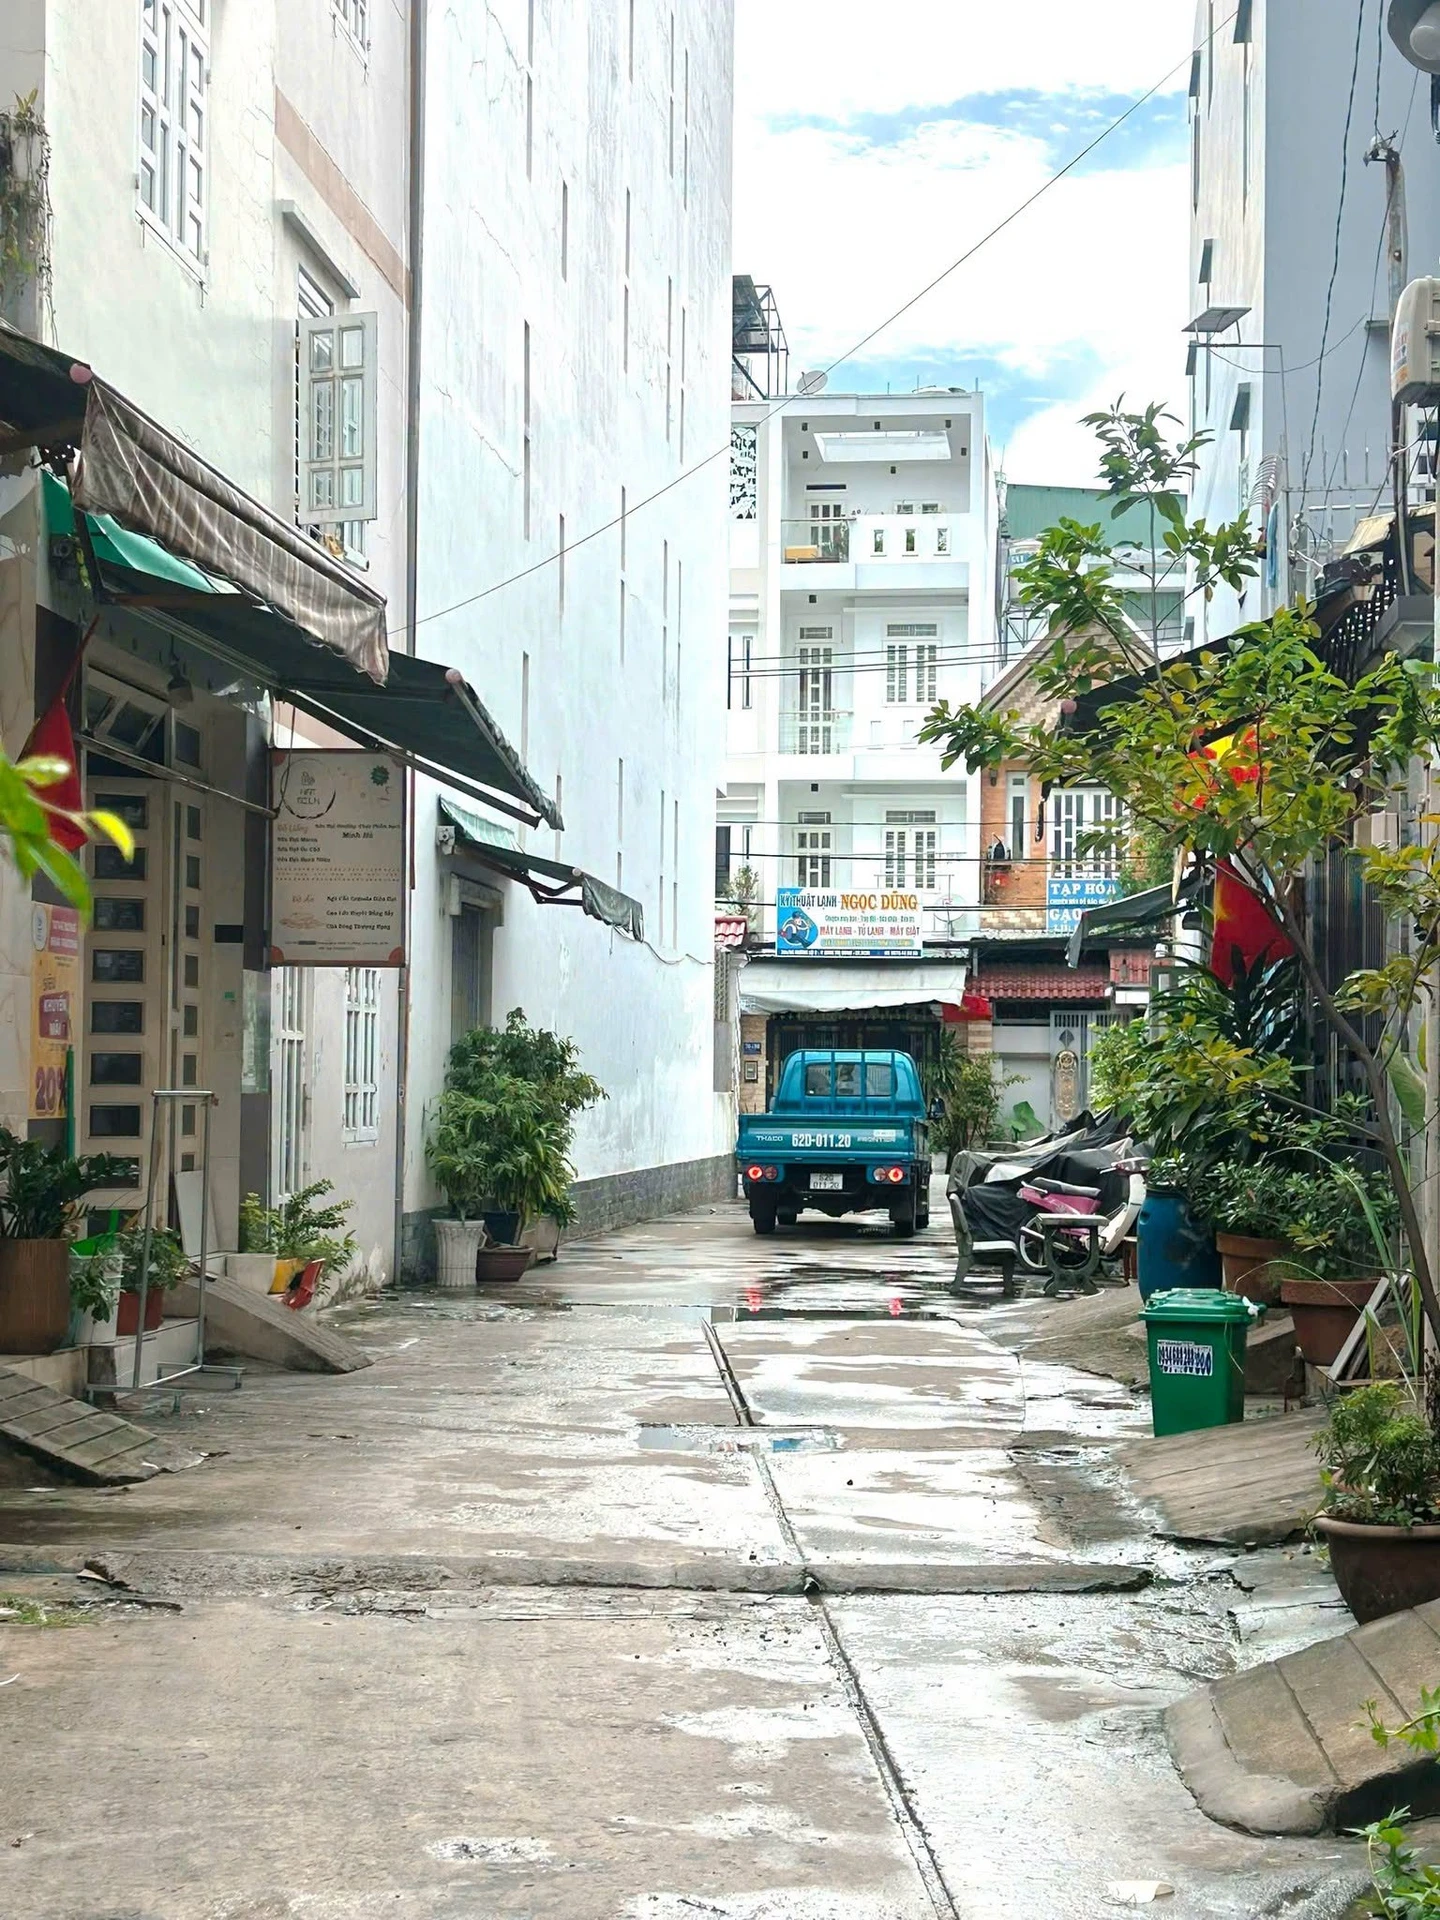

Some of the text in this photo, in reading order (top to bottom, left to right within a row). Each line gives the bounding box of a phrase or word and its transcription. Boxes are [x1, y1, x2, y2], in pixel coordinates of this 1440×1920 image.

[1051, 883, 1081, 897] TẠP
[792, 893, 815, 909] THUẬT
[817, 894, 837, 910] LẠNH
[840, 894, 878, 913] NGỌC
[881, 891, 918, 910] DŨNG
[1050, 908, 1082, 923] GẠO
[792, 1134, 851, 1148] 62D-011.20
